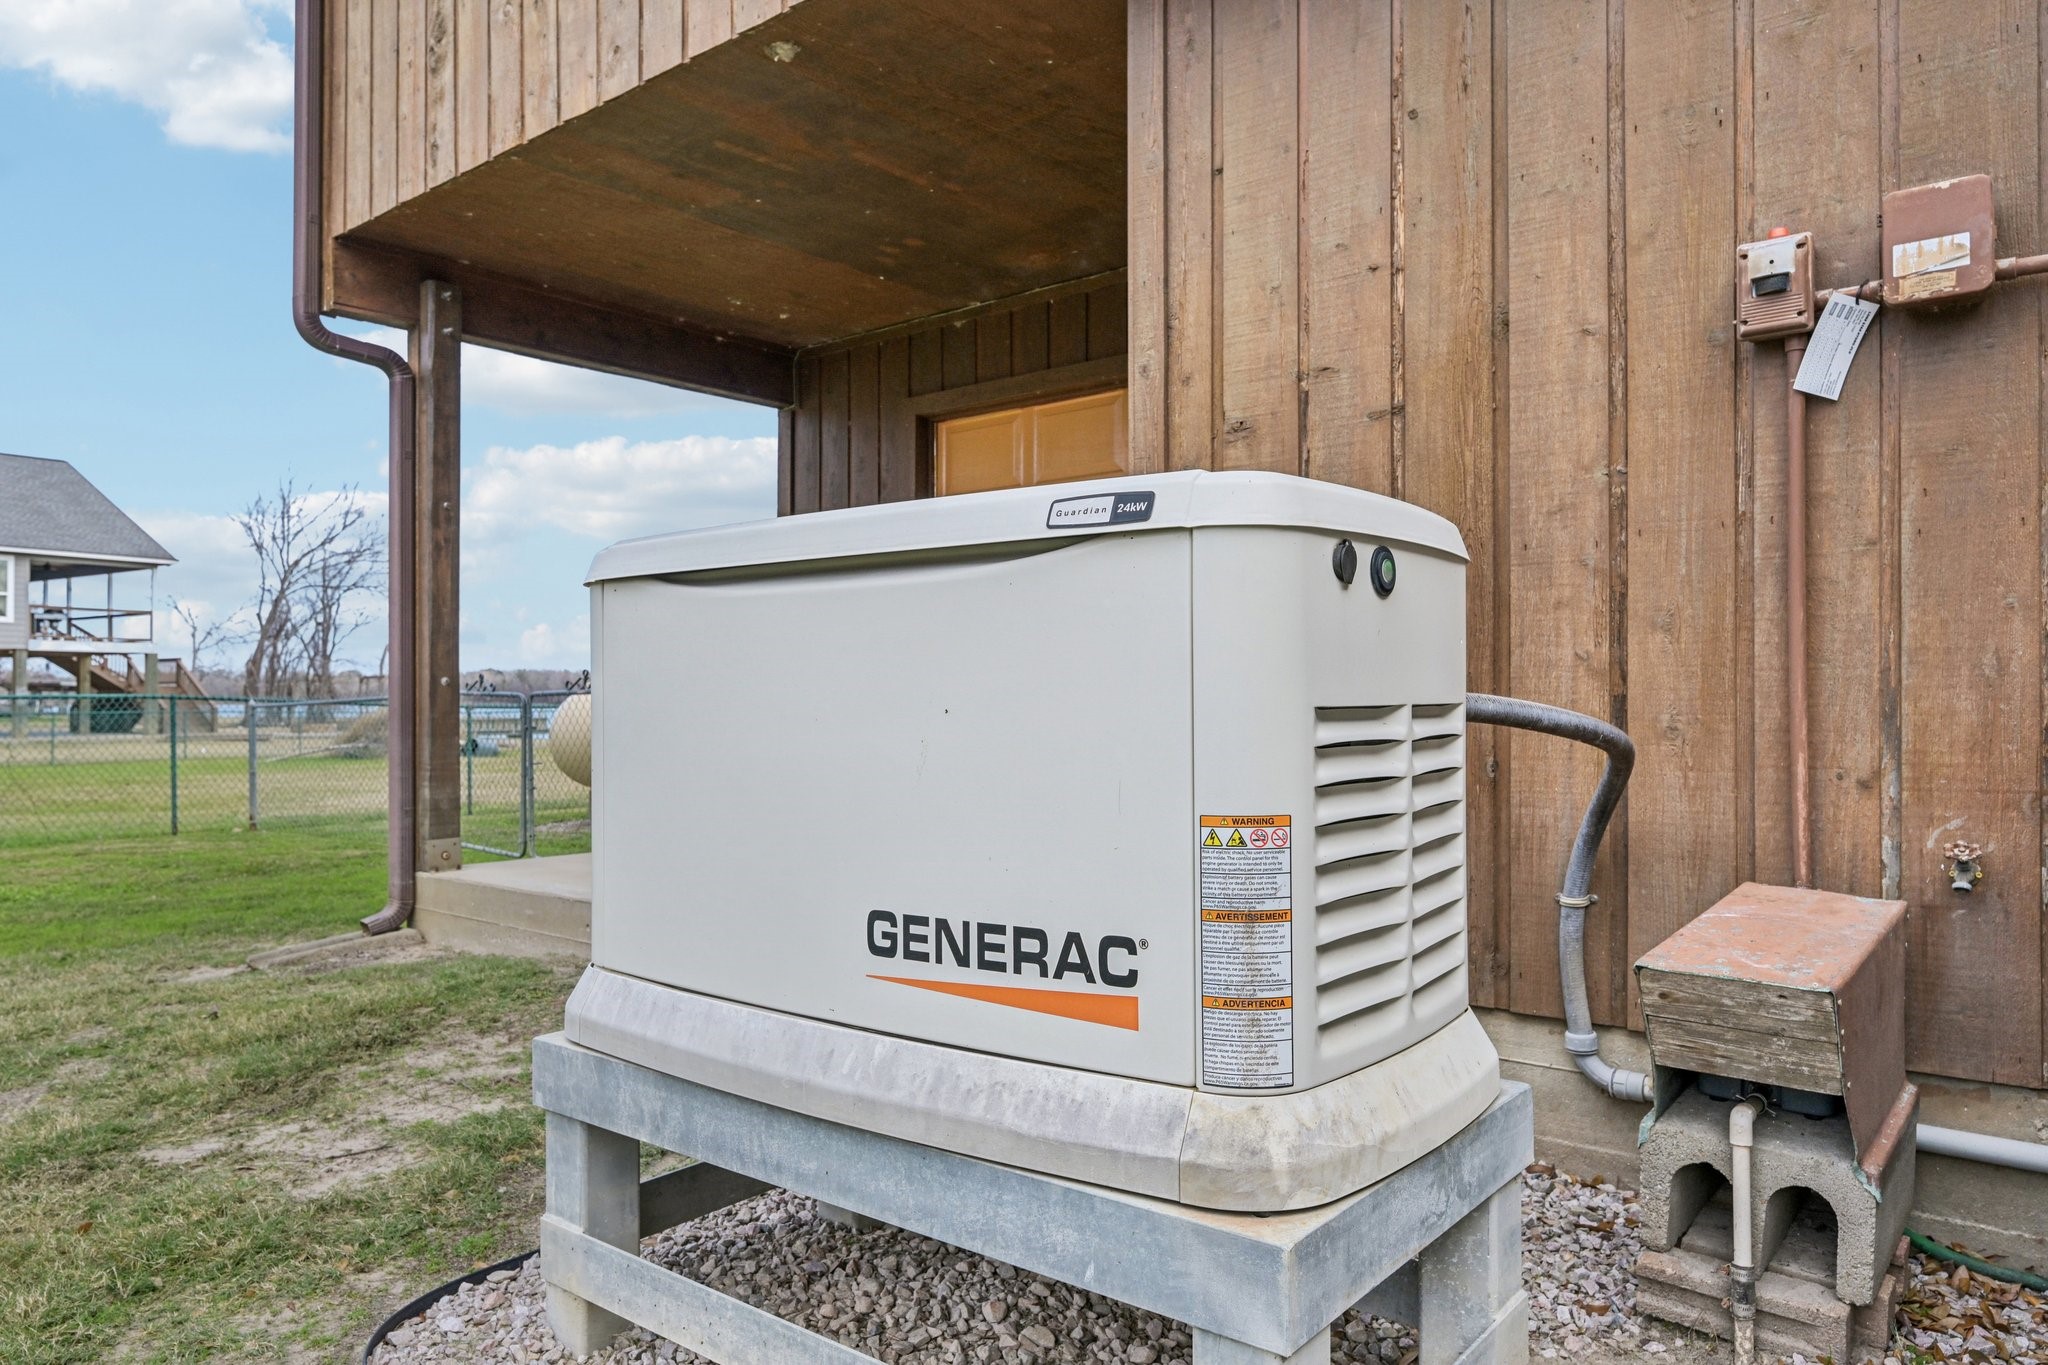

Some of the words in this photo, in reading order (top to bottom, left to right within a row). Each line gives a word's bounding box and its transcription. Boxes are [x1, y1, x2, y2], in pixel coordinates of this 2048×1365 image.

[1056, 506, 1107, 517] Guardian
[1117, 501, 1148, 513] 24kW
[1231, 817, 1275, 825] WARNING
[1215, 912, 1288, 921] AVERTISSEMENT
[1222, 999, 1286, 1007] ADVERTENCIA
